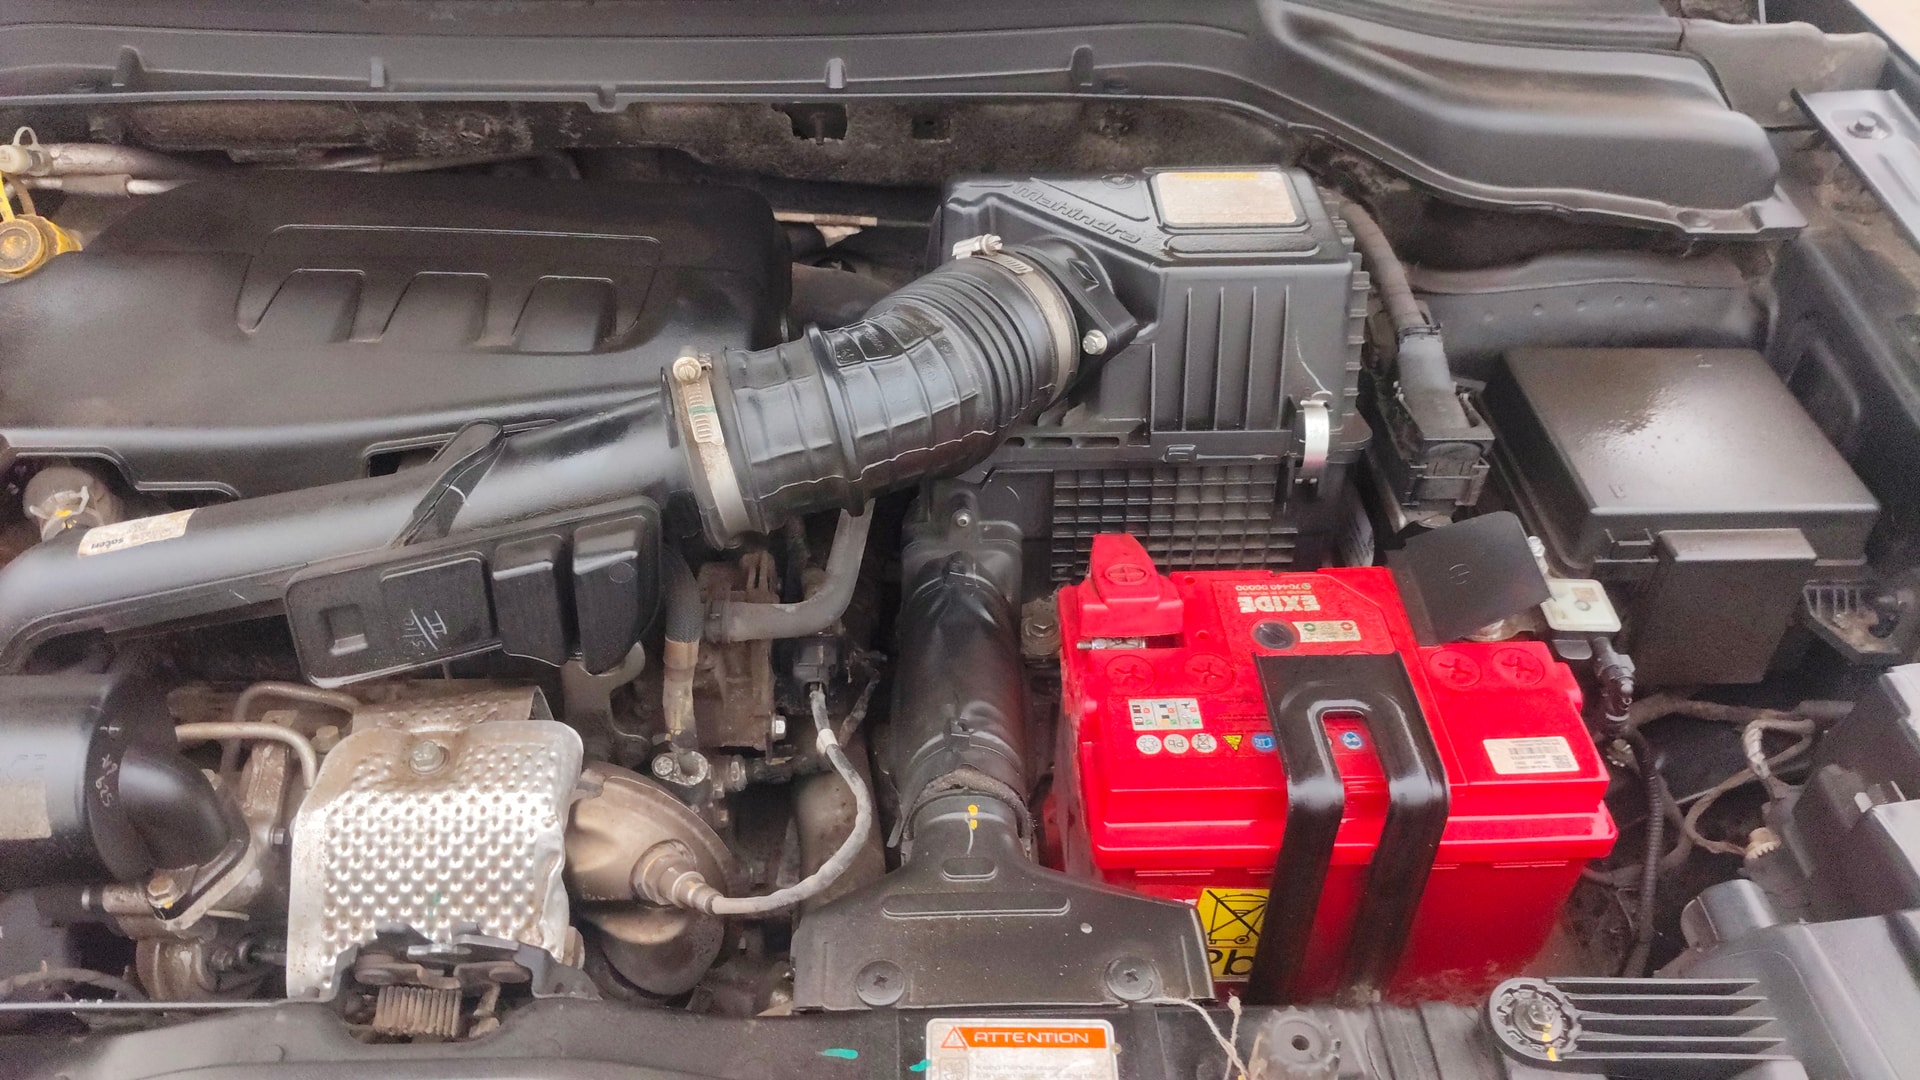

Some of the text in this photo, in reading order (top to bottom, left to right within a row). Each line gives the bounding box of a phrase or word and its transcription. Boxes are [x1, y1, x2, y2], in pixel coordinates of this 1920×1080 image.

[1012, 183, 1142, 244] Mahindra
[1237, 595, 1320, 613] EXIDE
[1168, 739, 1184, 748] Pb
[974, 1031, 1089, 1044] ATTENTION
